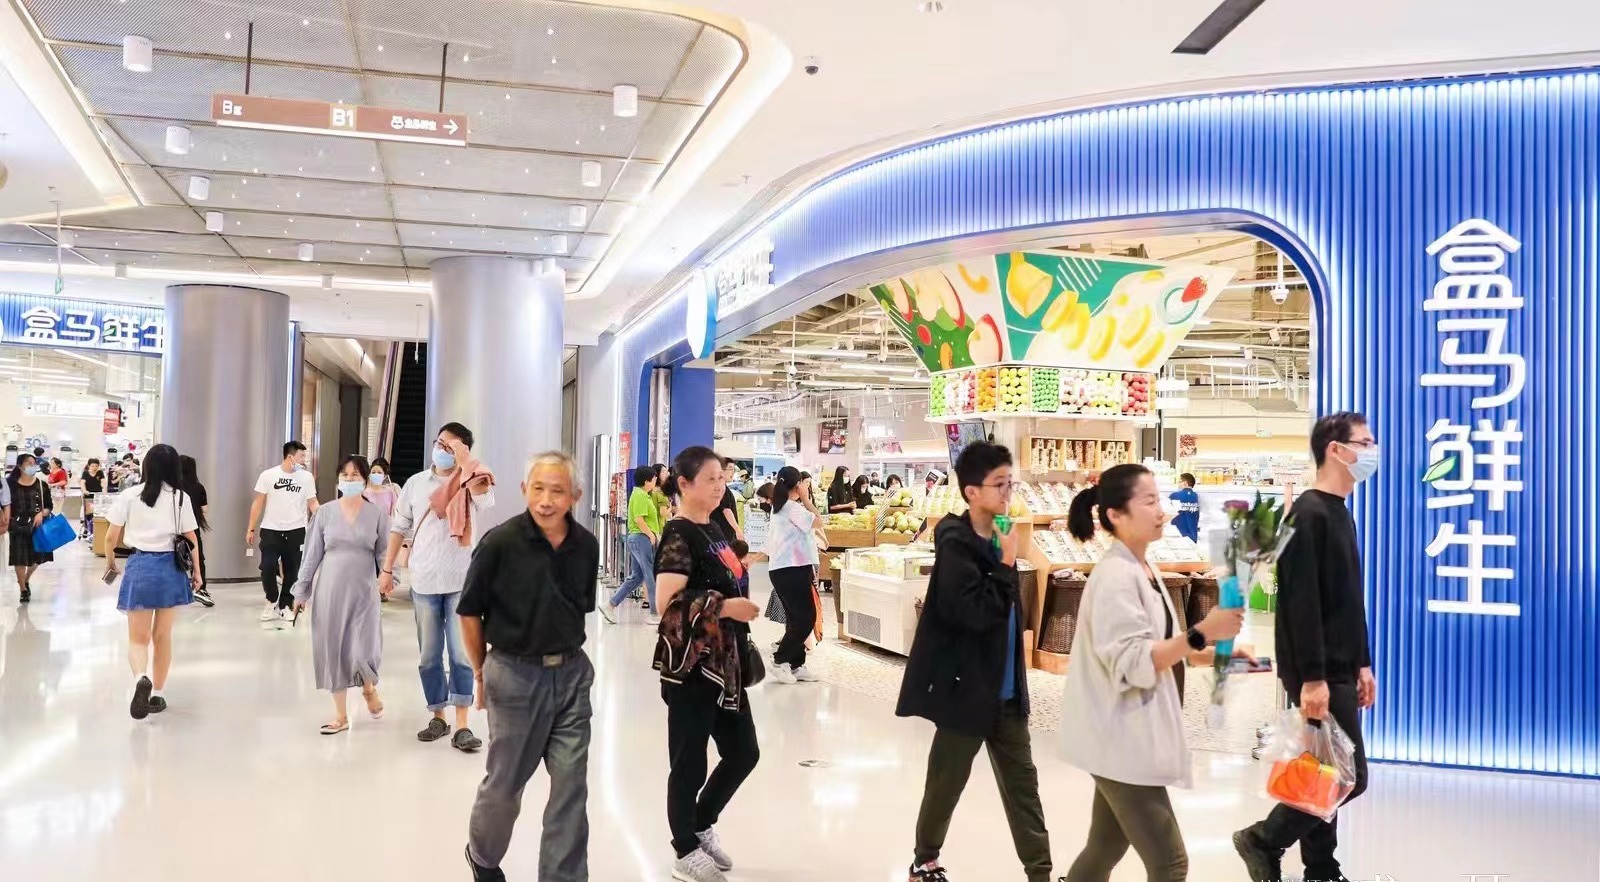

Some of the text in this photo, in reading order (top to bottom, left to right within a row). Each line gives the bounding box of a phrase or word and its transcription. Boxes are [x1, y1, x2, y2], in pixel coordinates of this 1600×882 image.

[332, 107, 354, 128] B1
[20, 307, 163, 352] 盒马鲜生
[1421, 217, 1526, 617] 盒马鲜生
